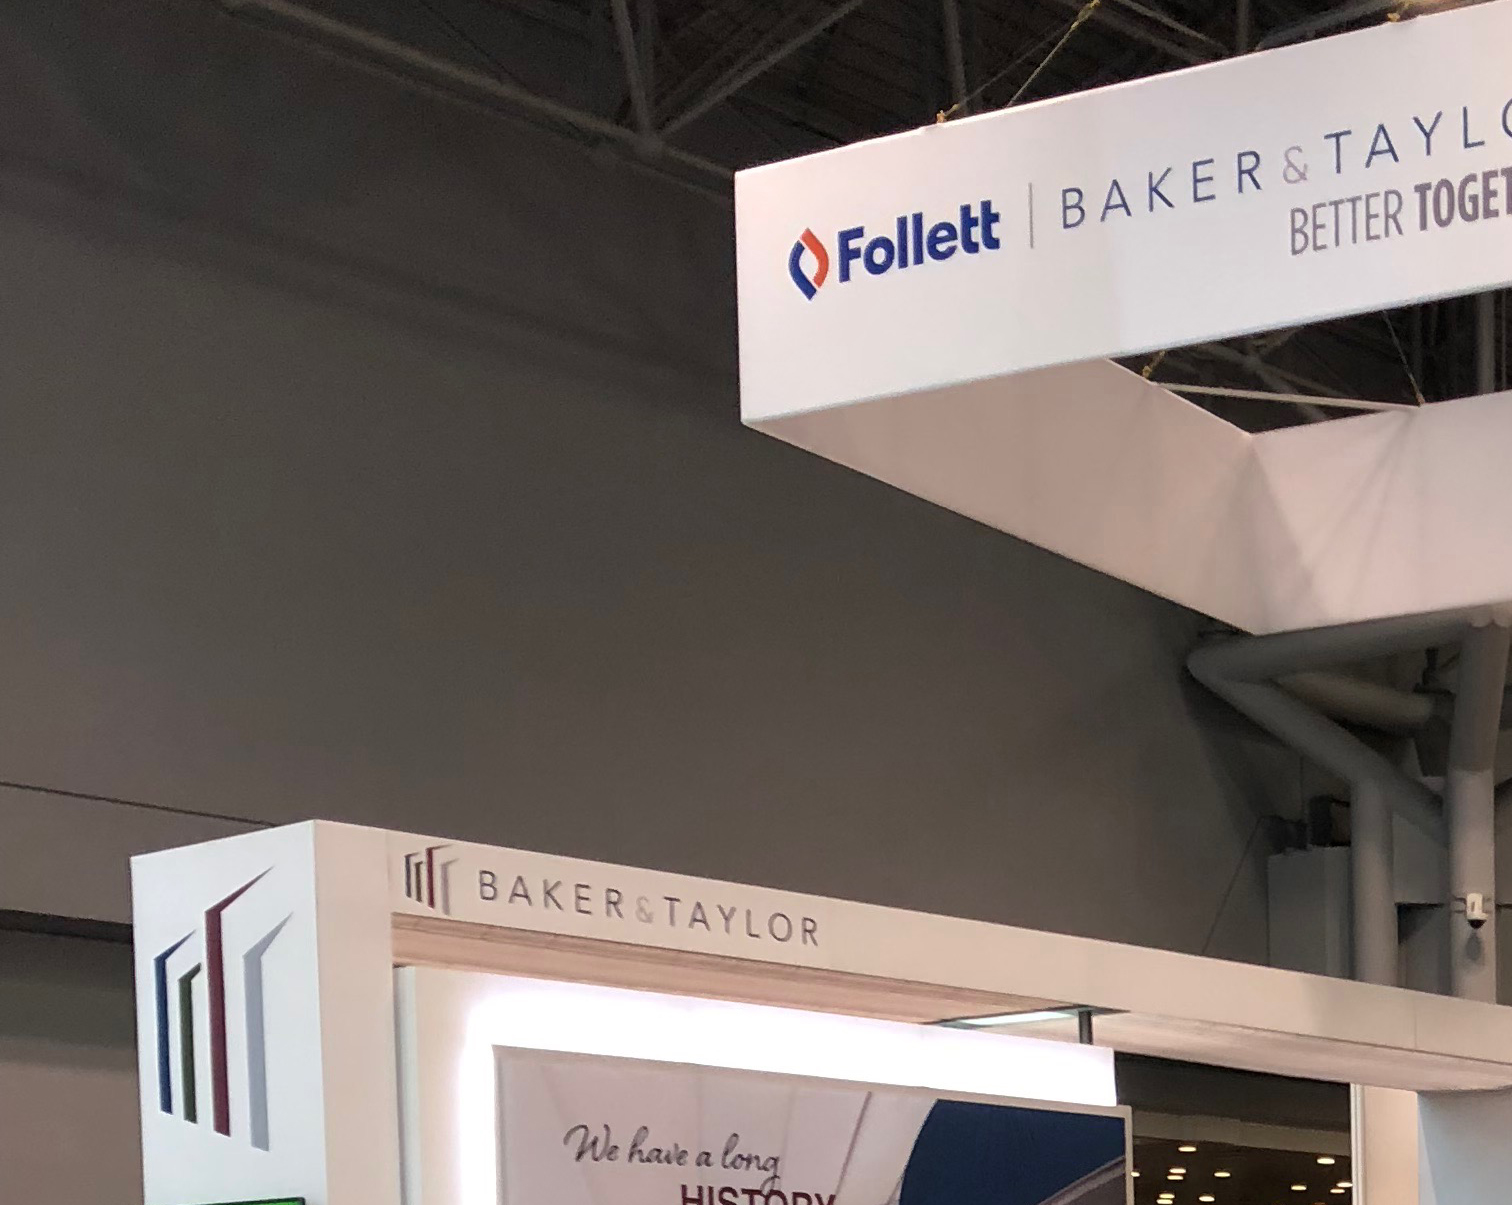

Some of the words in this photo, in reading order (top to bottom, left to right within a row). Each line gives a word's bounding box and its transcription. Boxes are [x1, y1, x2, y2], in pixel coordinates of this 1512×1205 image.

[837, 199, 1000, 283] Follett
[1290, 190, 1405, 256] BETTER
[563, 1123, 620, 1163] We
[627, 1125, 689, 1167] have
[695, 1151, 715, 1168] a
[720, 1132, 780, 1196] long
